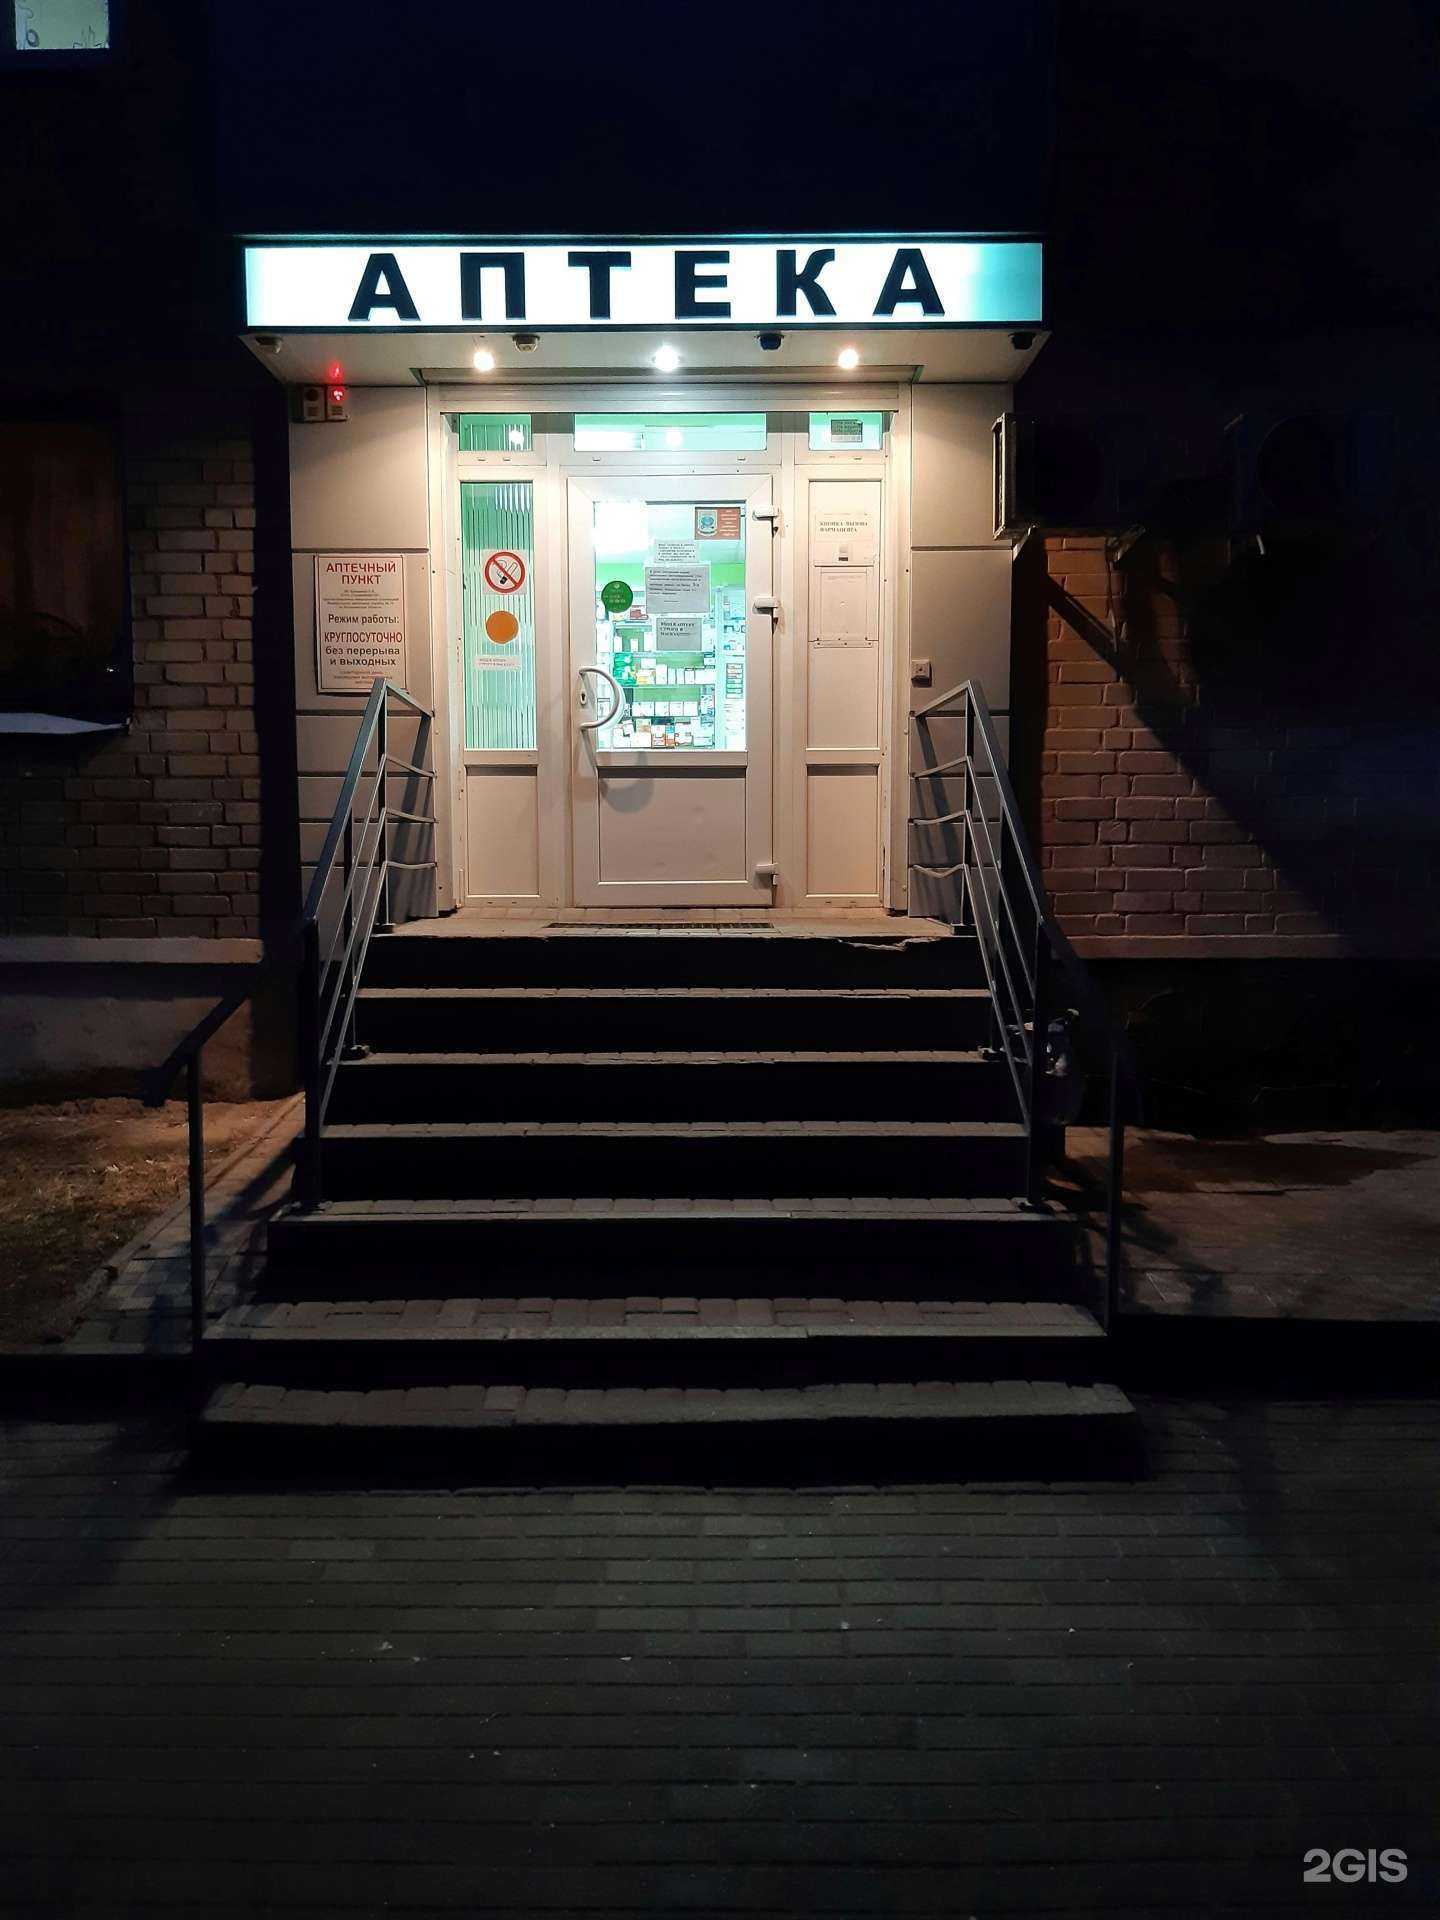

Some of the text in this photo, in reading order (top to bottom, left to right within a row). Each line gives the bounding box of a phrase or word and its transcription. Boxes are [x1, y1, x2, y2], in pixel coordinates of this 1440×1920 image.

[347, 248, 946, 322] АПТЕКА
[326, 561, 396, 572] АПТЕЧНЫЙ
[341, 575, 381, 584] ПУНКТ
[328, 614, 400, 625] Режим работы:
[324, 632, 403, 642] КРУГЛОСУТОЧНО
[325, 646, 400, 656] без перерыва
